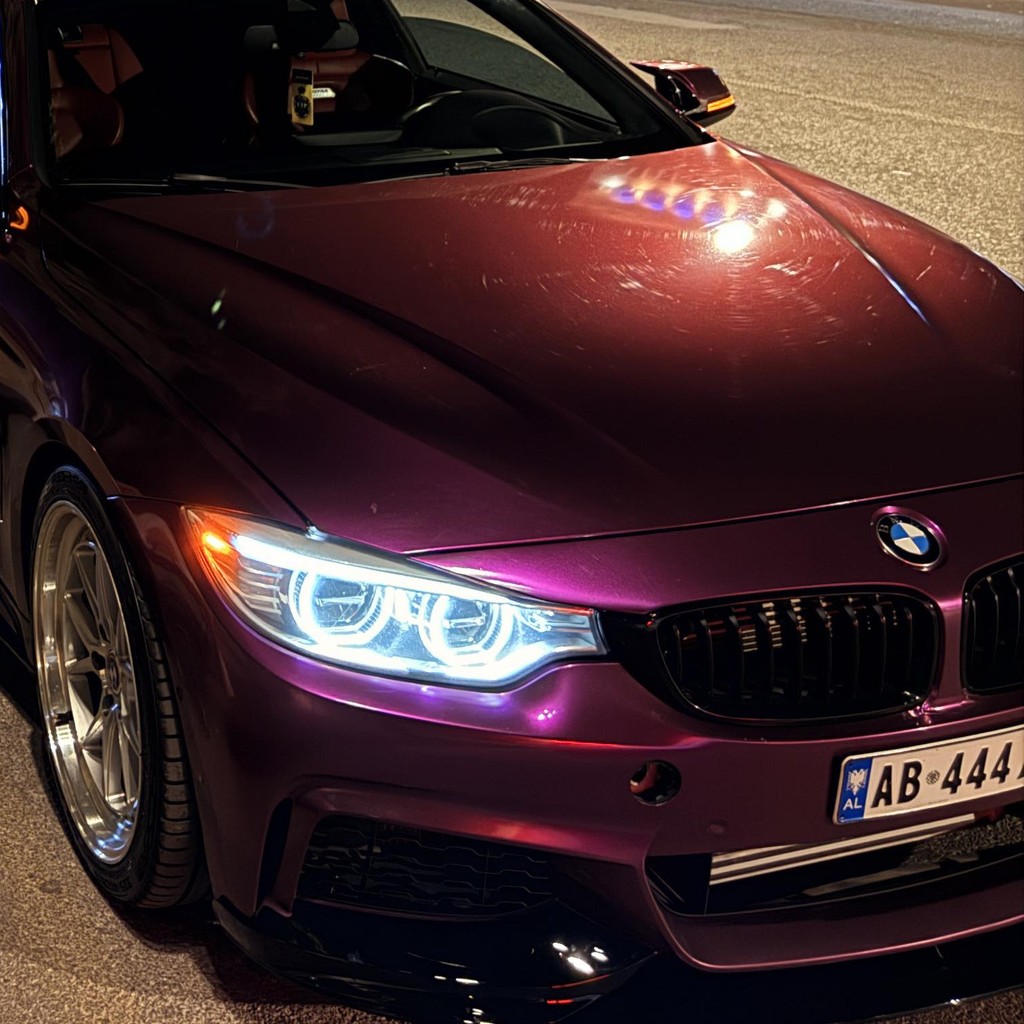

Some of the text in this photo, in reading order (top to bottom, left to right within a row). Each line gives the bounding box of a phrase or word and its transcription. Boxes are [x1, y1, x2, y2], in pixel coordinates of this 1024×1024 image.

[870, 741, 1024, 808] AB 444
[842, 798, 863, 811] AL
